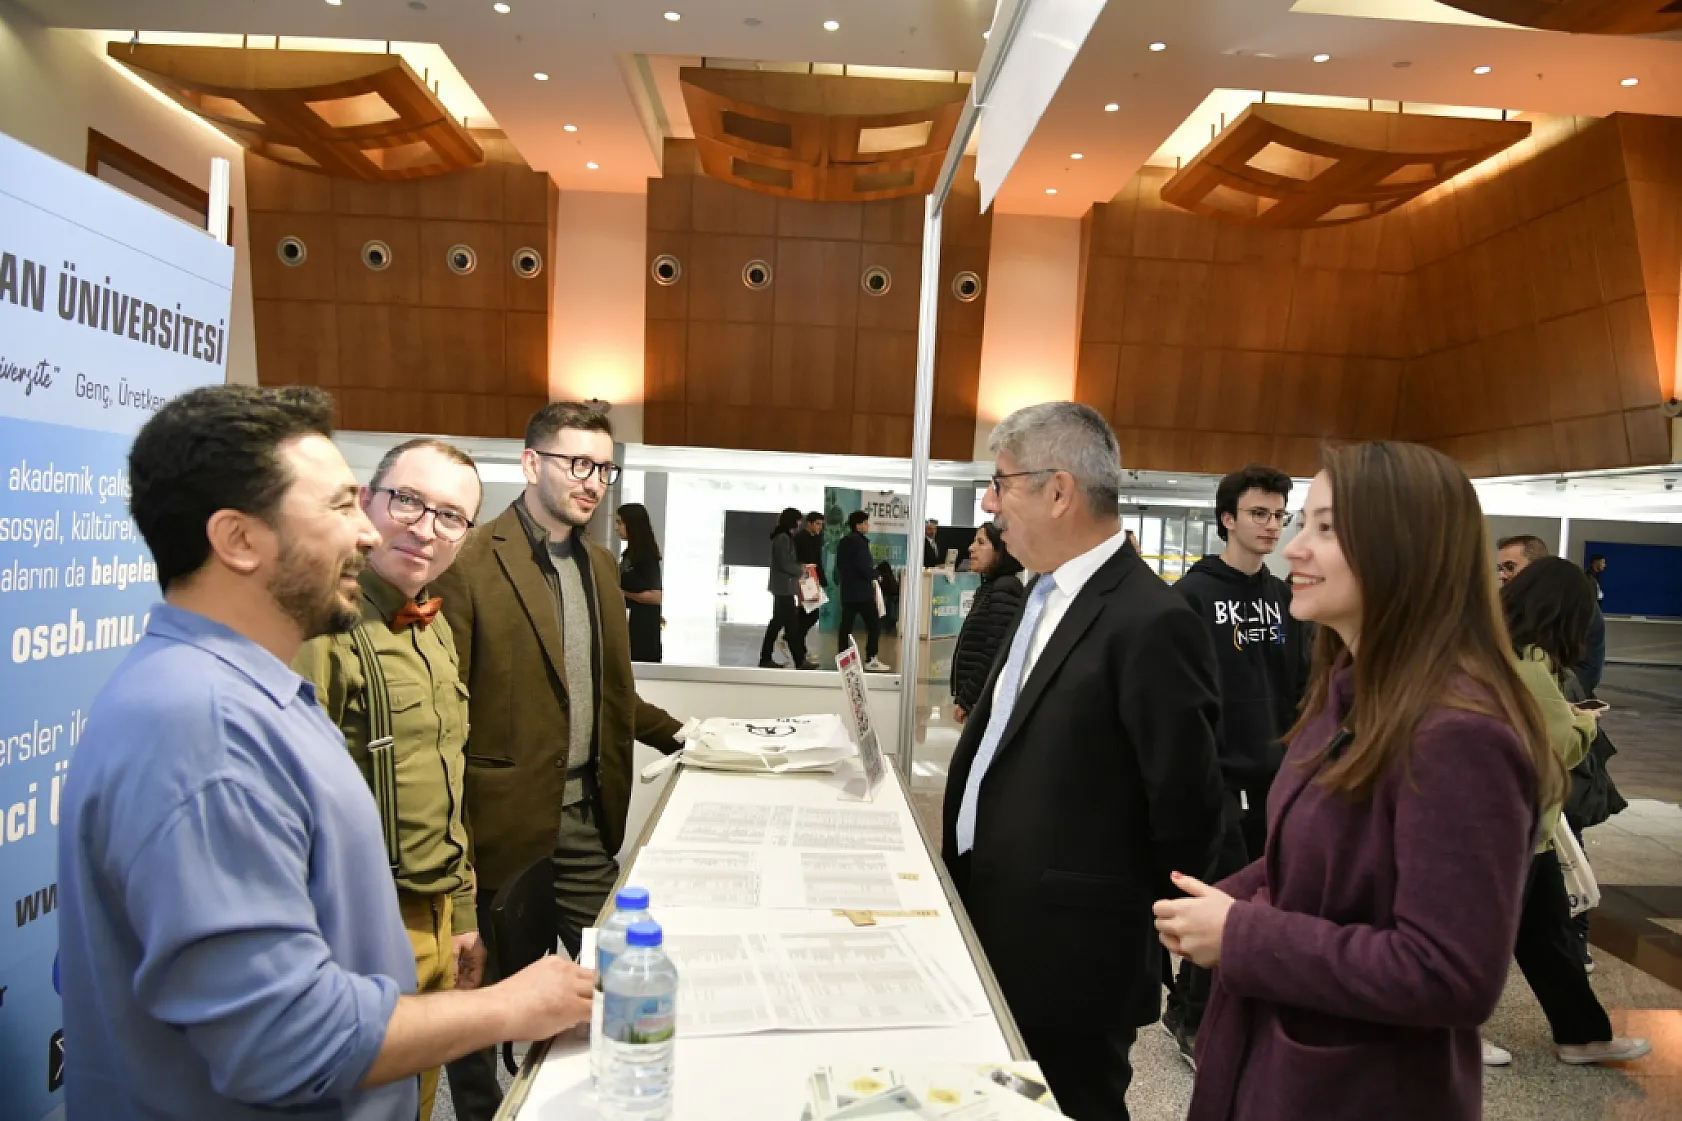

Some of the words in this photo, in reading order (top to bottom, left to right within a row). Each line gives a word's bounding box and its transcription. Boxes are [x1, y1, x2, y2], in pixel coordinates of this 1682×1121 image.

[0, 252, 46, 313] AN
[57, 260, 225, 366] ÜNİVERSİTESİ
[9, 459, 94, 496] akademik
[0, 509, 65, 548] sosyal,
[71, 509, 137, 544] kültürel,
[1, 559, 59, 593] alarını
[65, 557, 86, 588] da
[1213, 598, 1282, 626] BKLYN
[1237, 625, 1279, 645] NETS
[0, 782, 38, 848] ci
